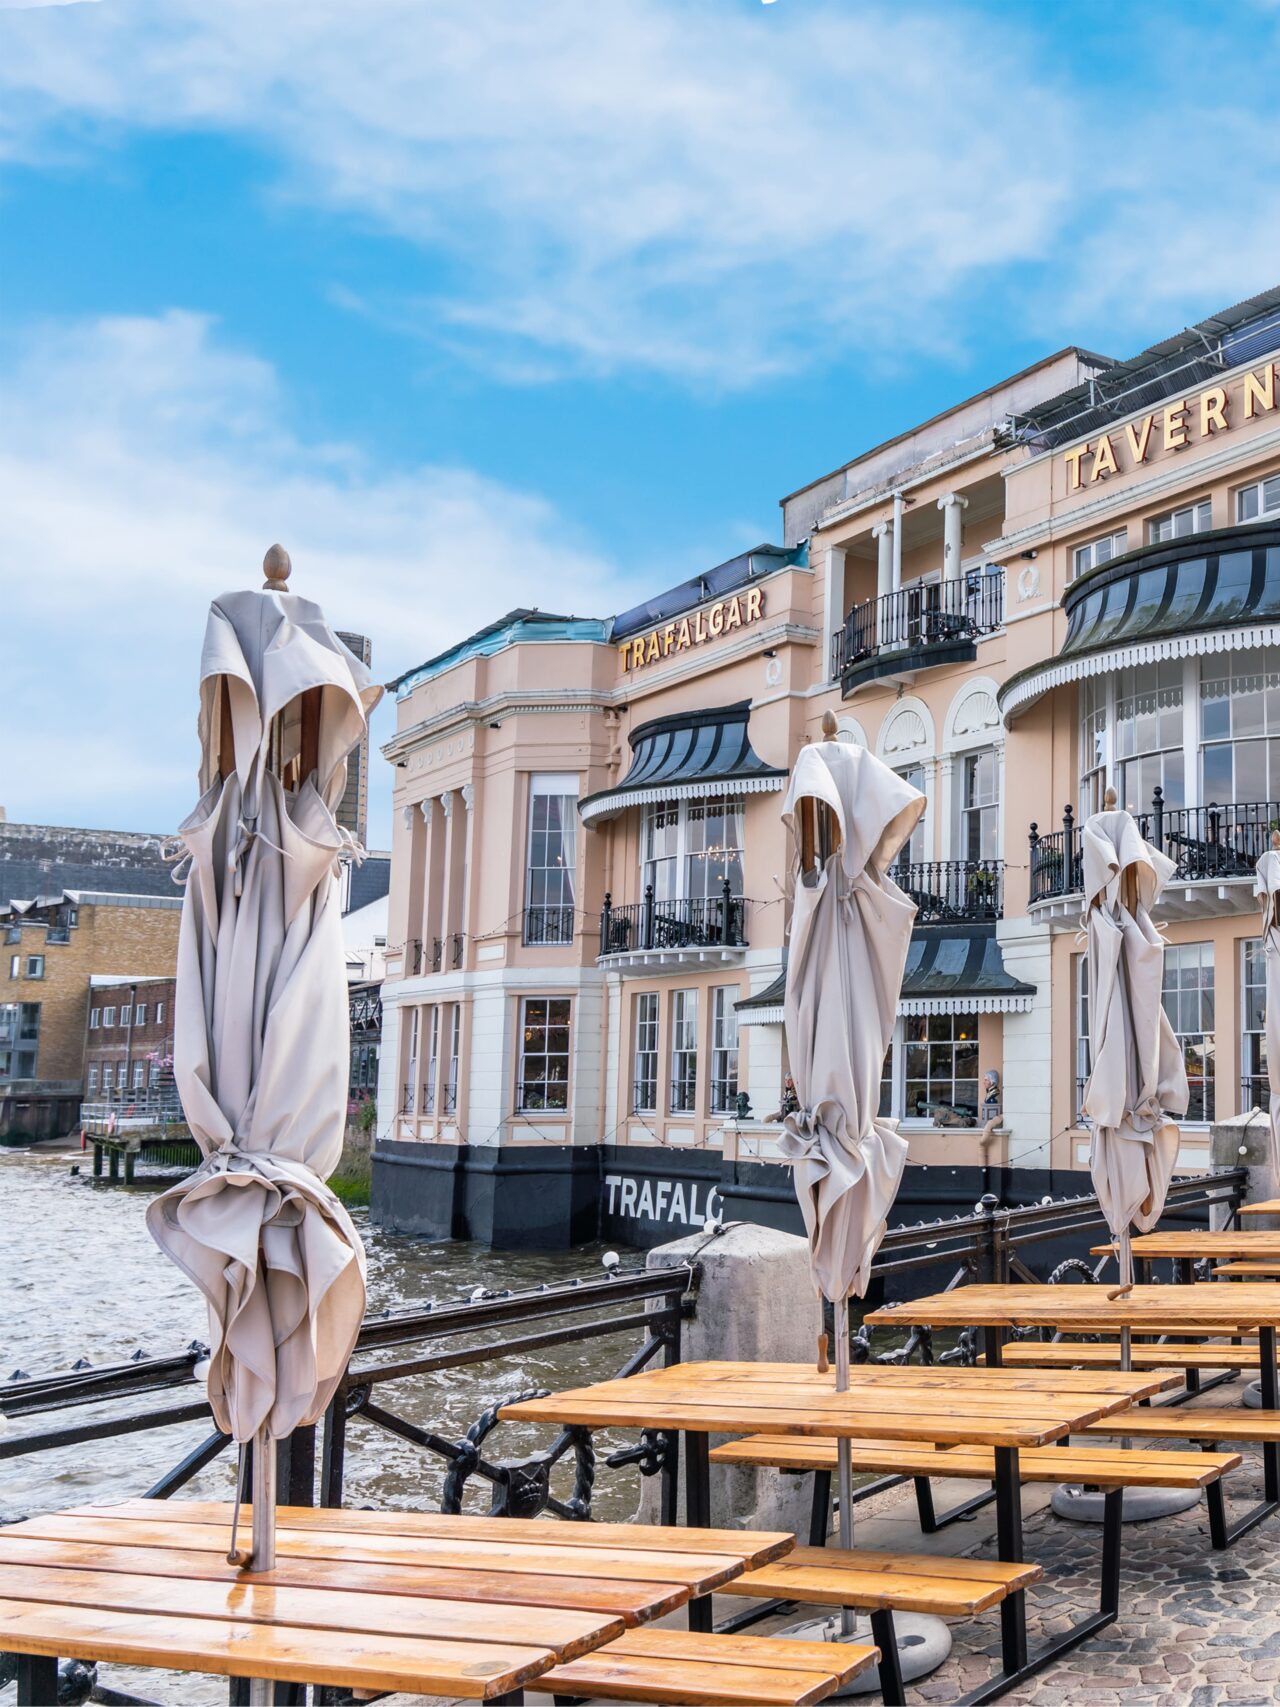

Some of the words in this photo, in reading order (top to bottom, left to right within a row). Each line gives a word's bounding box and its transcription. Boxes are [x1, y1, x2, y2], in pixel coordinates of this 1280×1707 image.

[1064, 363, 1278, 489] TAVERN
[618, 587, 764, 673] TRAFALGAR
[605, 1175, 724, 1227] TRAFALG
